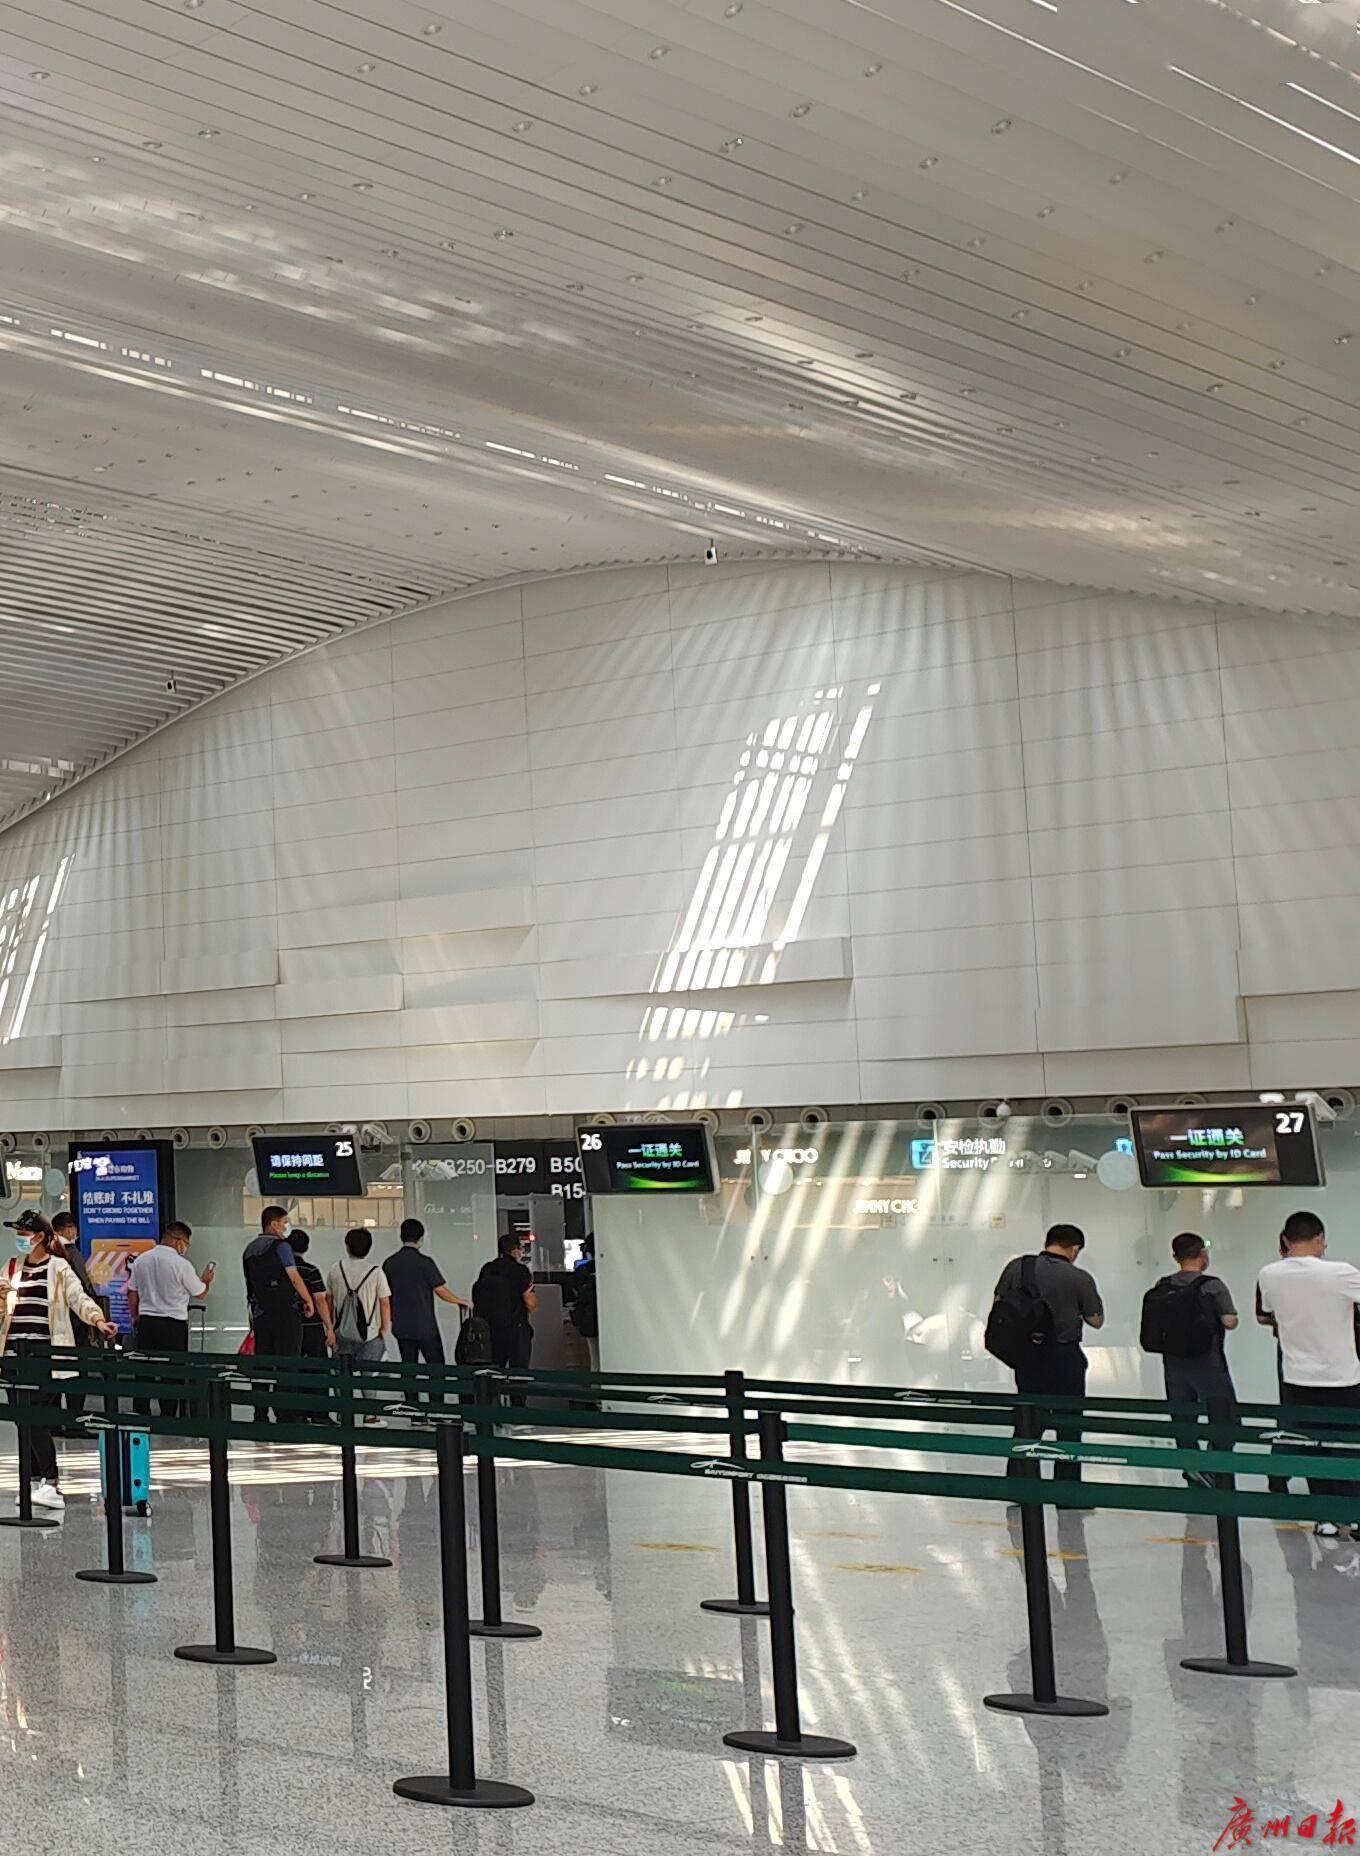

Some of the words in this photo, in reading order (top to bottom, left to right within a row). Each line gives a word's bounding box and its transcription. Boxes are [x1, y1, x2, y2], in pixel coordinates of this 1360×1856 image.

[1275, 1112, 1305, 1133] 27
[580, 1134, 602, 1150] 26
[1169, 1128, 1244, 1147] 一证通关
[335, 1142, 353, 1157] 25
[628, 1143, 683, 1157] 一证通关
[1153, 1150, 1174, 1160] Pass
[1176, 1150, 1214, 1160] Security
[1216, 1150, 1228, 1161] by
[1230, 1150, 1242, 1159] ID
[1243, 1148, 1267, 1159] Card
[270, 1154, 325, 1167] 请保持间距
[633, 1161, 661, 1170] Security
[942, 1158, 989, 1171] Security
